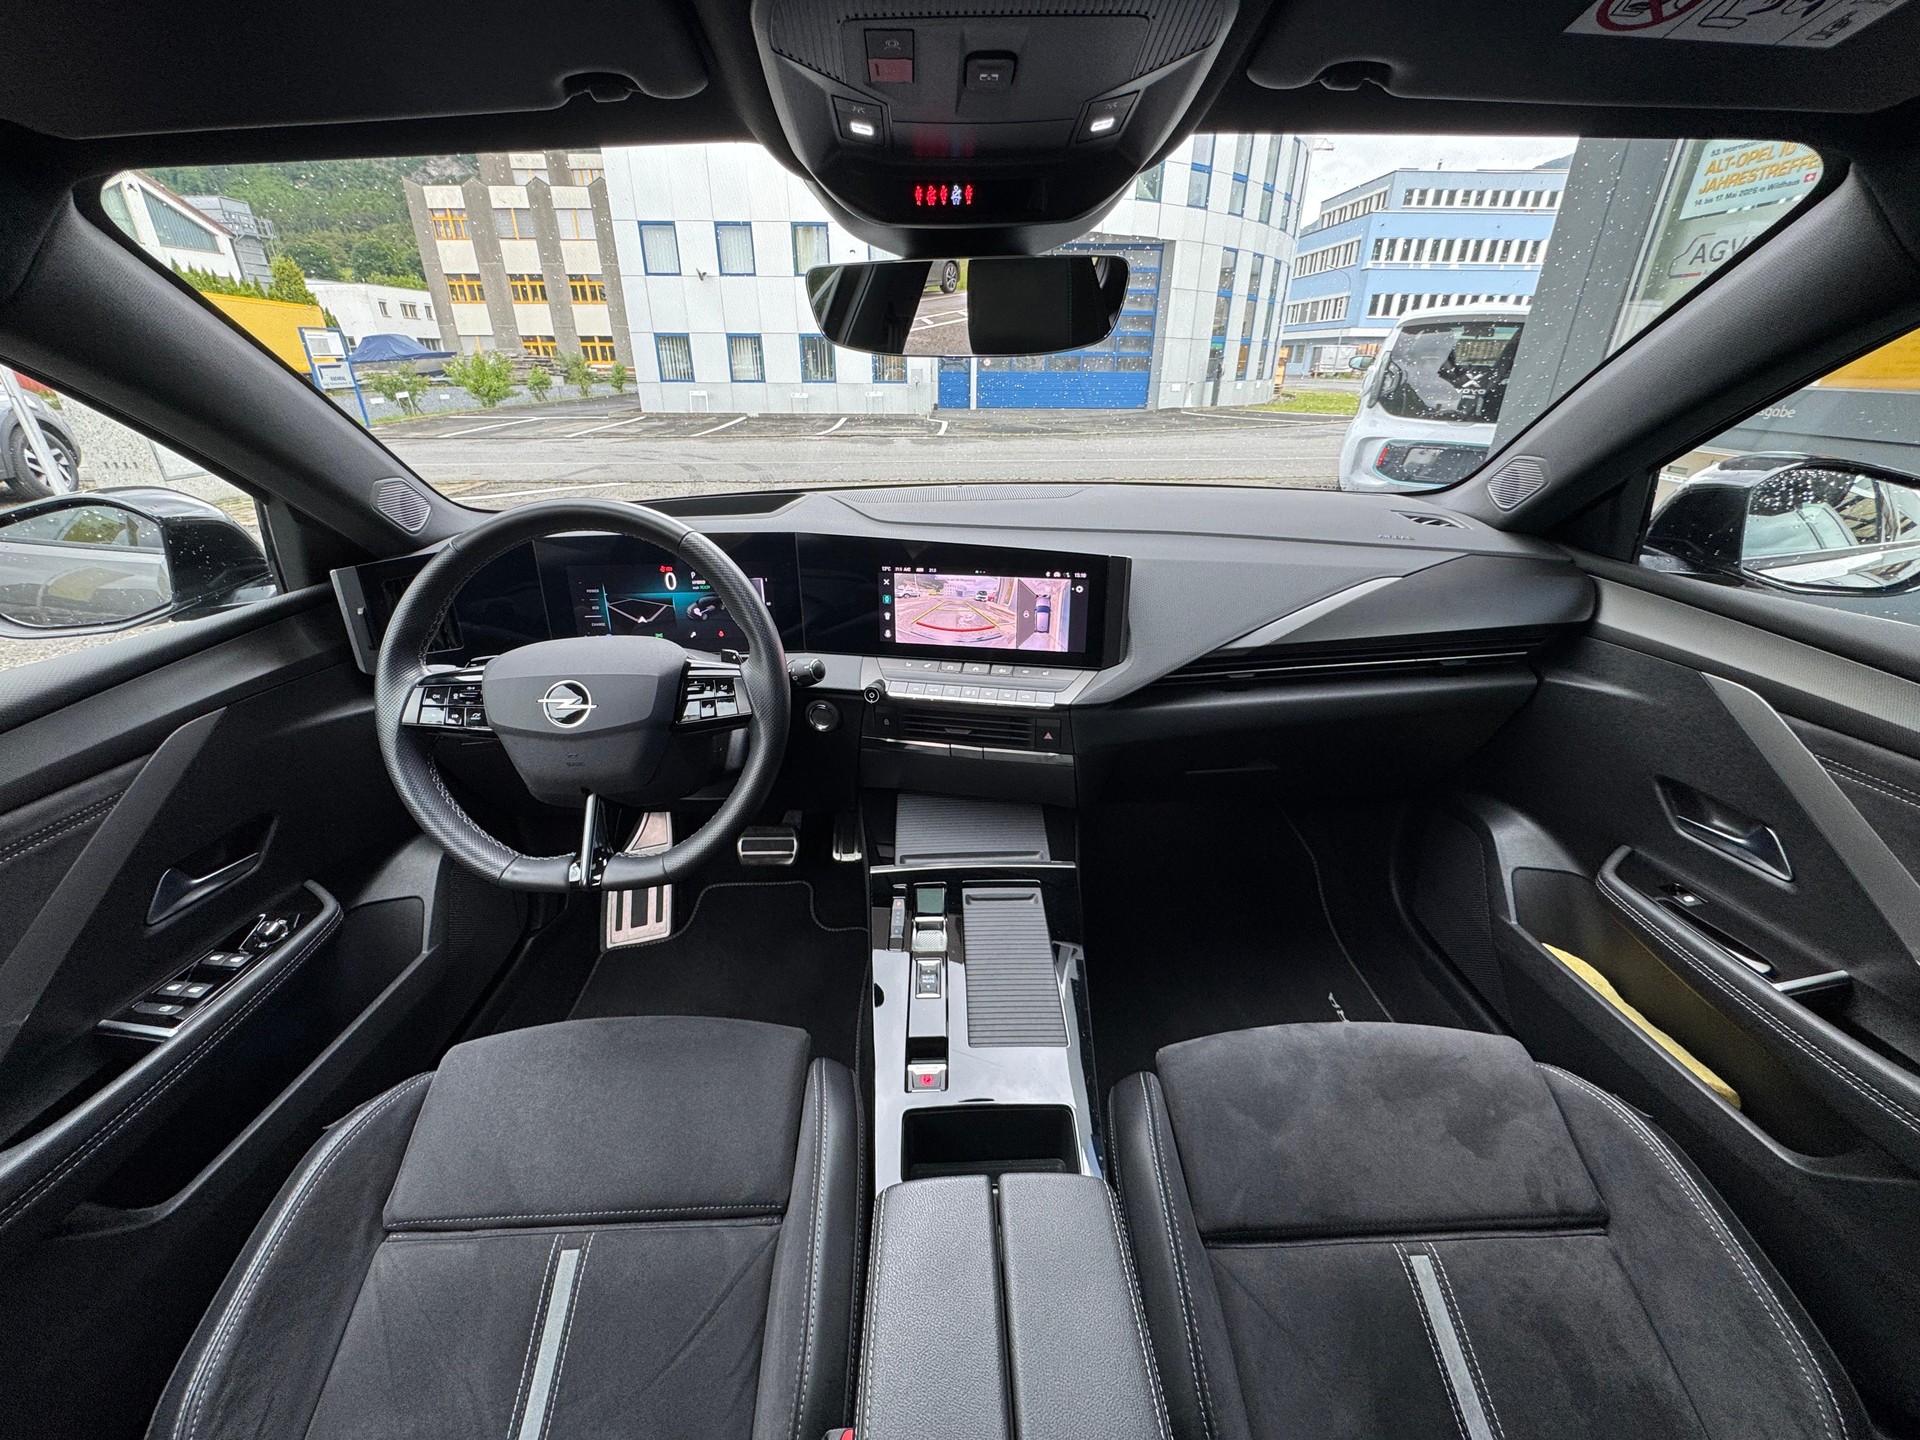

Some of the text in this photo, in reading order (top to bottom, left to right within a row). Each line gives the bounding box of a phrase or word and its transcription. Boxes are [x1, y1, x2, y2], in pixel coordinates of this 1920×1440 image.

[1698, 154, 1821, 195] JAHRESTREFFE
[1704, 145, 1775, 176] ALT-OPEL
[1688, 236, 1756, 265] AGV
